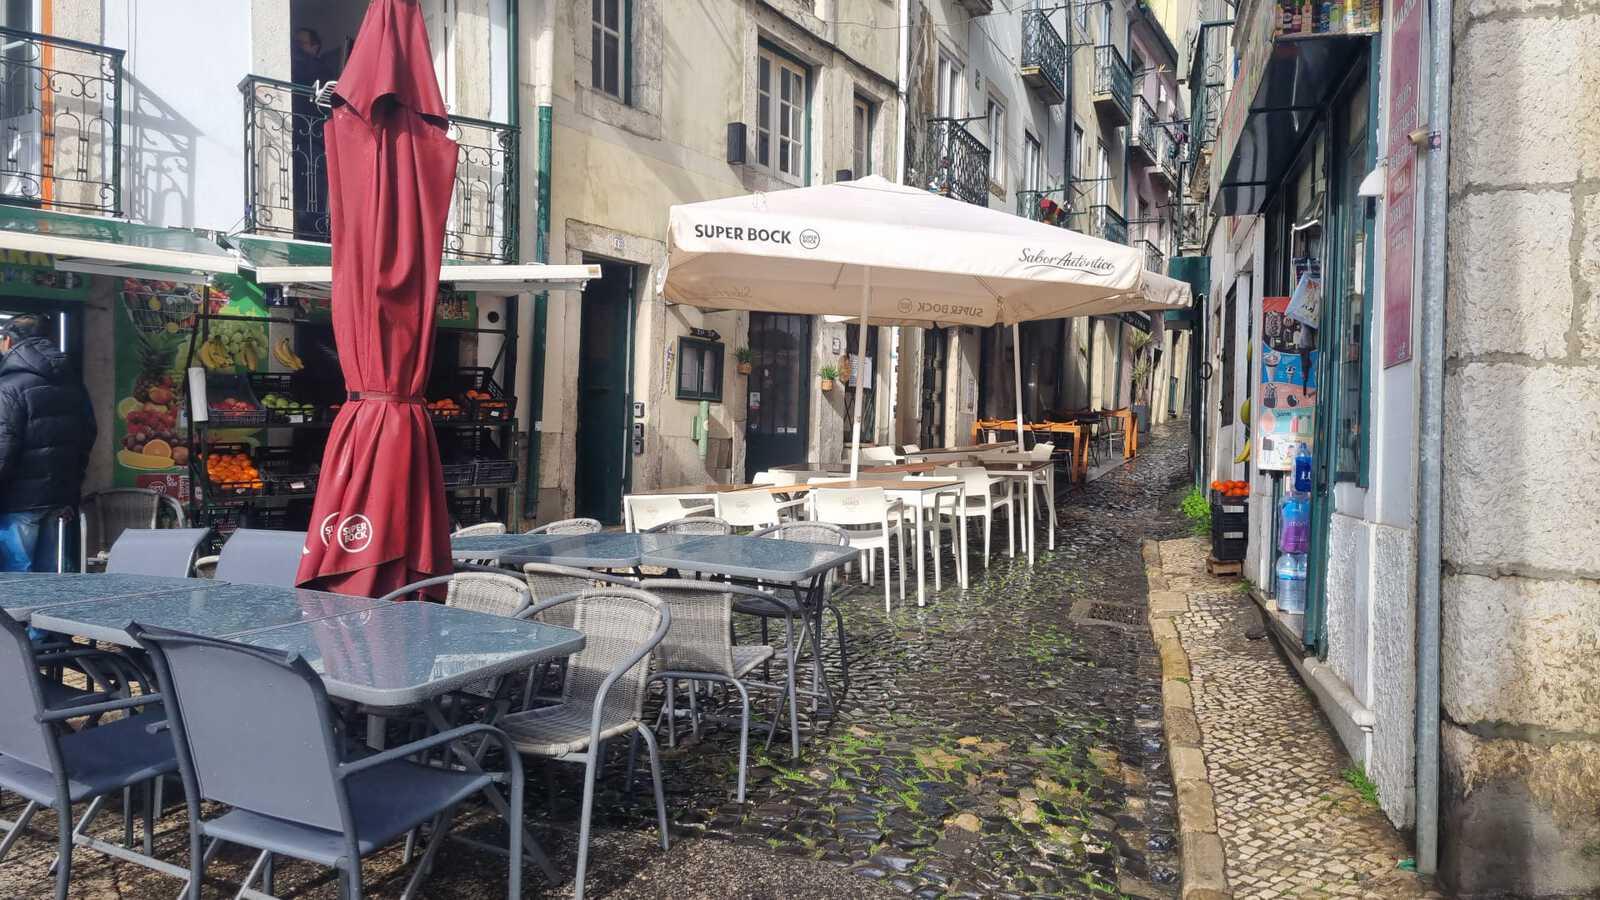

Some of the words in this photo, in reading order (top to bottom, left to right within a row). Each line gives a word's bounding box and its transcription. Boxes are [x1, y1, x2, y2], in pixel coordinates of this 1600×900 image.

[694, 223, 743, 241] SUPER
[747, 227, 791, 244] BOCK
[1018, 247, 1057, 264] Sabor
